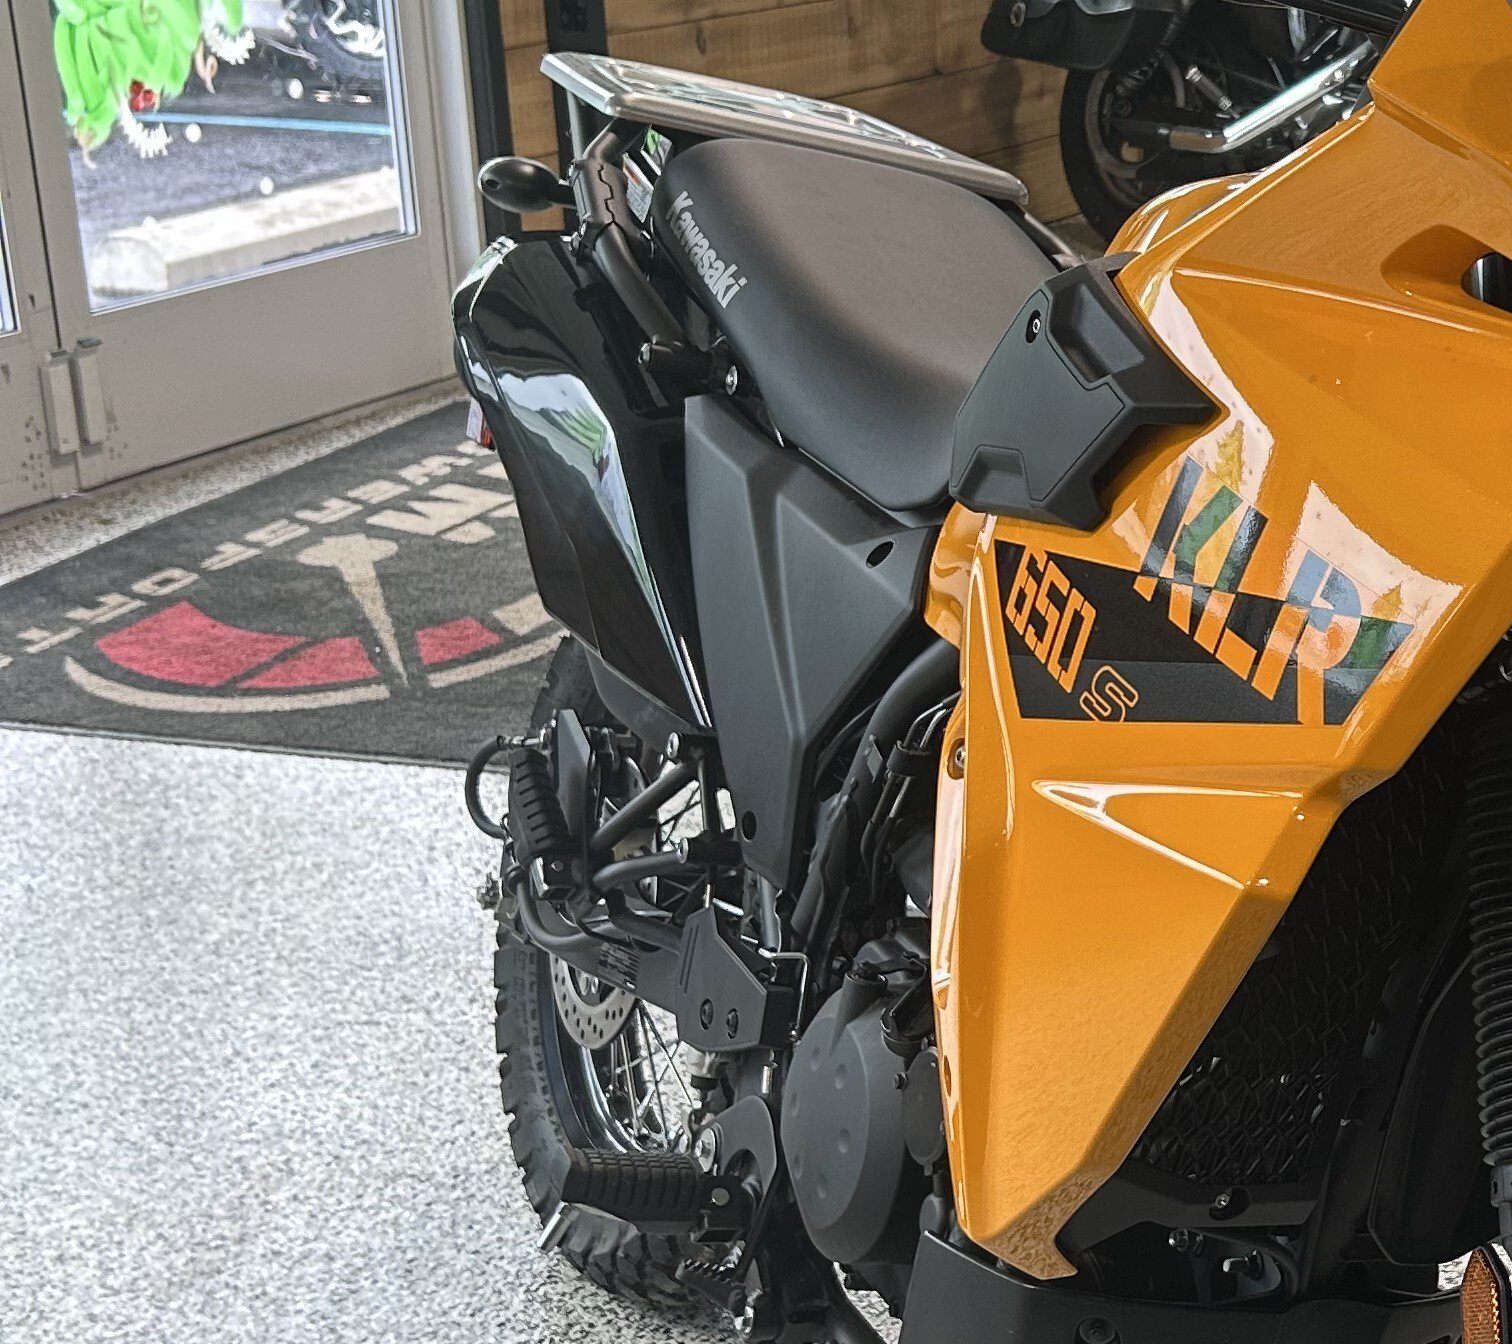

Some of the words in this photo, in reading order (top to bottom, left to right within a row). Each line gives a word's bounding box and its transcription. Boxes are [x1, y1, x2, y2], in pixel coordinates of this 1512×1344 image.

[666, 190, 748, 308] Kawasaki
[0, 440, 497, 669] WERSPORT
[1004, 545, 1097, 693] 650
[1078, 665, 1140, 722] S
[1133, 453, 1362, 725] KLR
